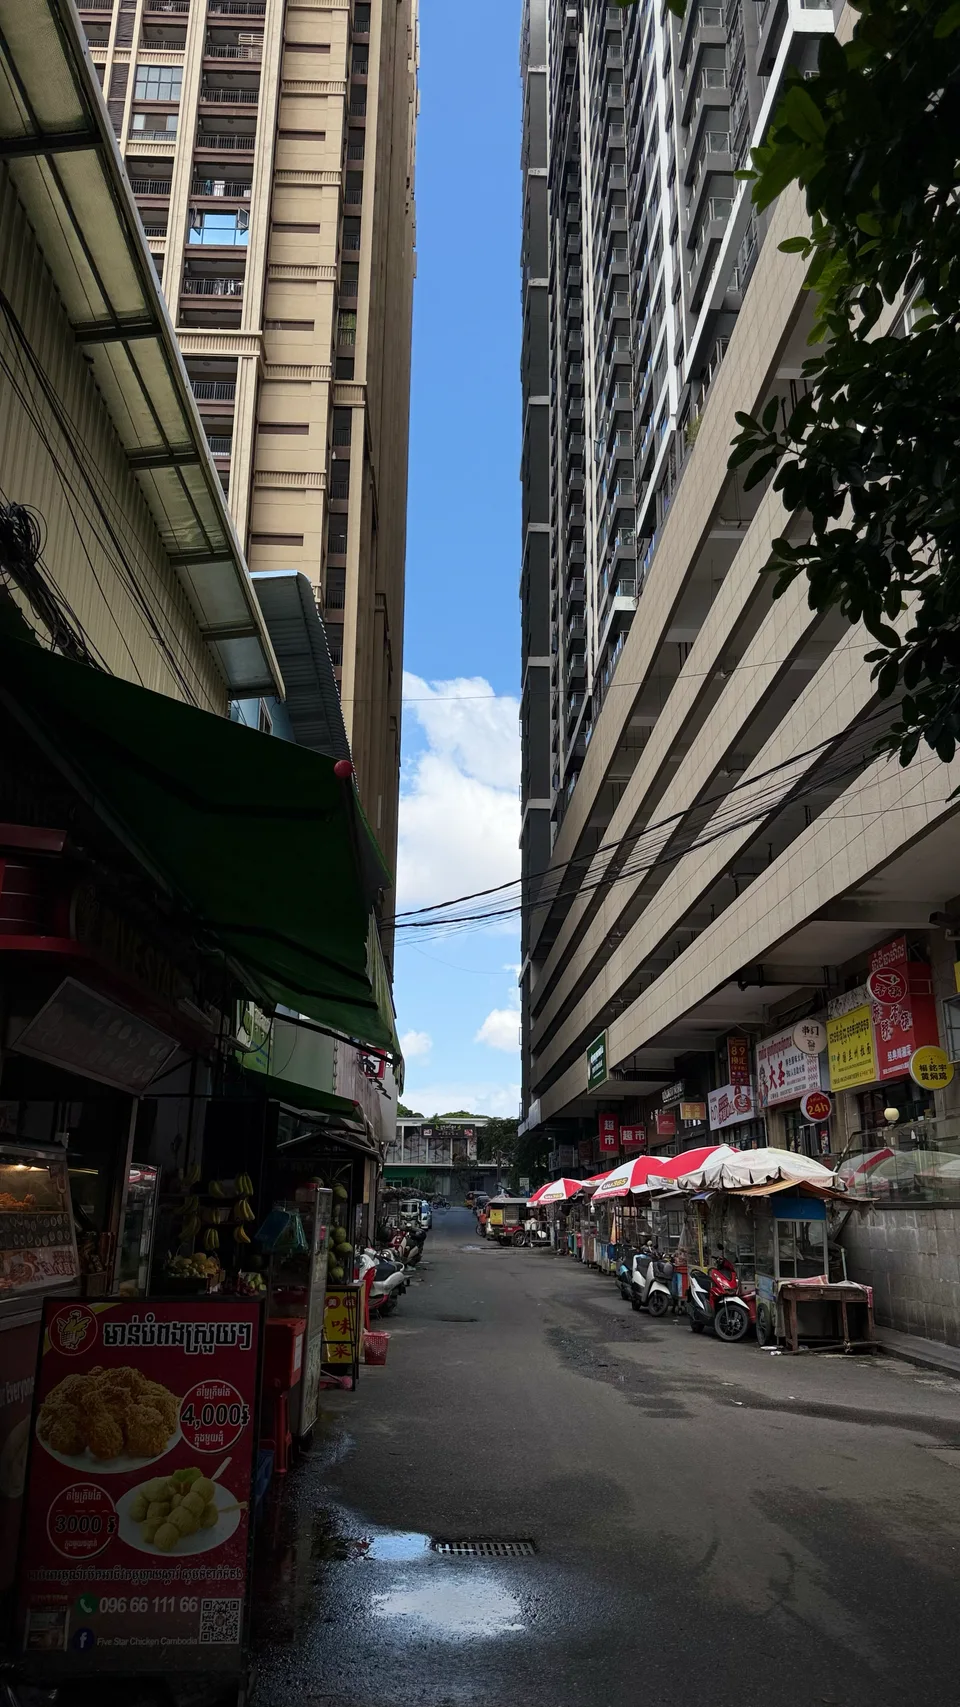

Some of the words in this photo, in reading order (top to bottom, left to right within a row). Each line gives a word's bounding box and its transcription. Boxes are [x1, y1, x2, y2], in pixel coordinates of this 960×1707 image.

[769, 1060, 785, 1090] 大圣
[807, 1102, 829, 1115] 24h
[604, 1120, 615, 1146] 超市
[622, 1129, 645, 1142] 超市
[54, 1514, 103, 1534] 3000
[99, 1596, 128, 1614] 096
[129, 1596, 149, 1614] 66
[151, 1595, 175, 1613] 111
[178, 1595, 198, 1613] 66
[96, 1637, 112, 1646] Five
[113, 1637, 129, 1646] Star
[130, 1636, 160, 1646] Chicken
[160, 1635, 198, 1646] Cambodia
